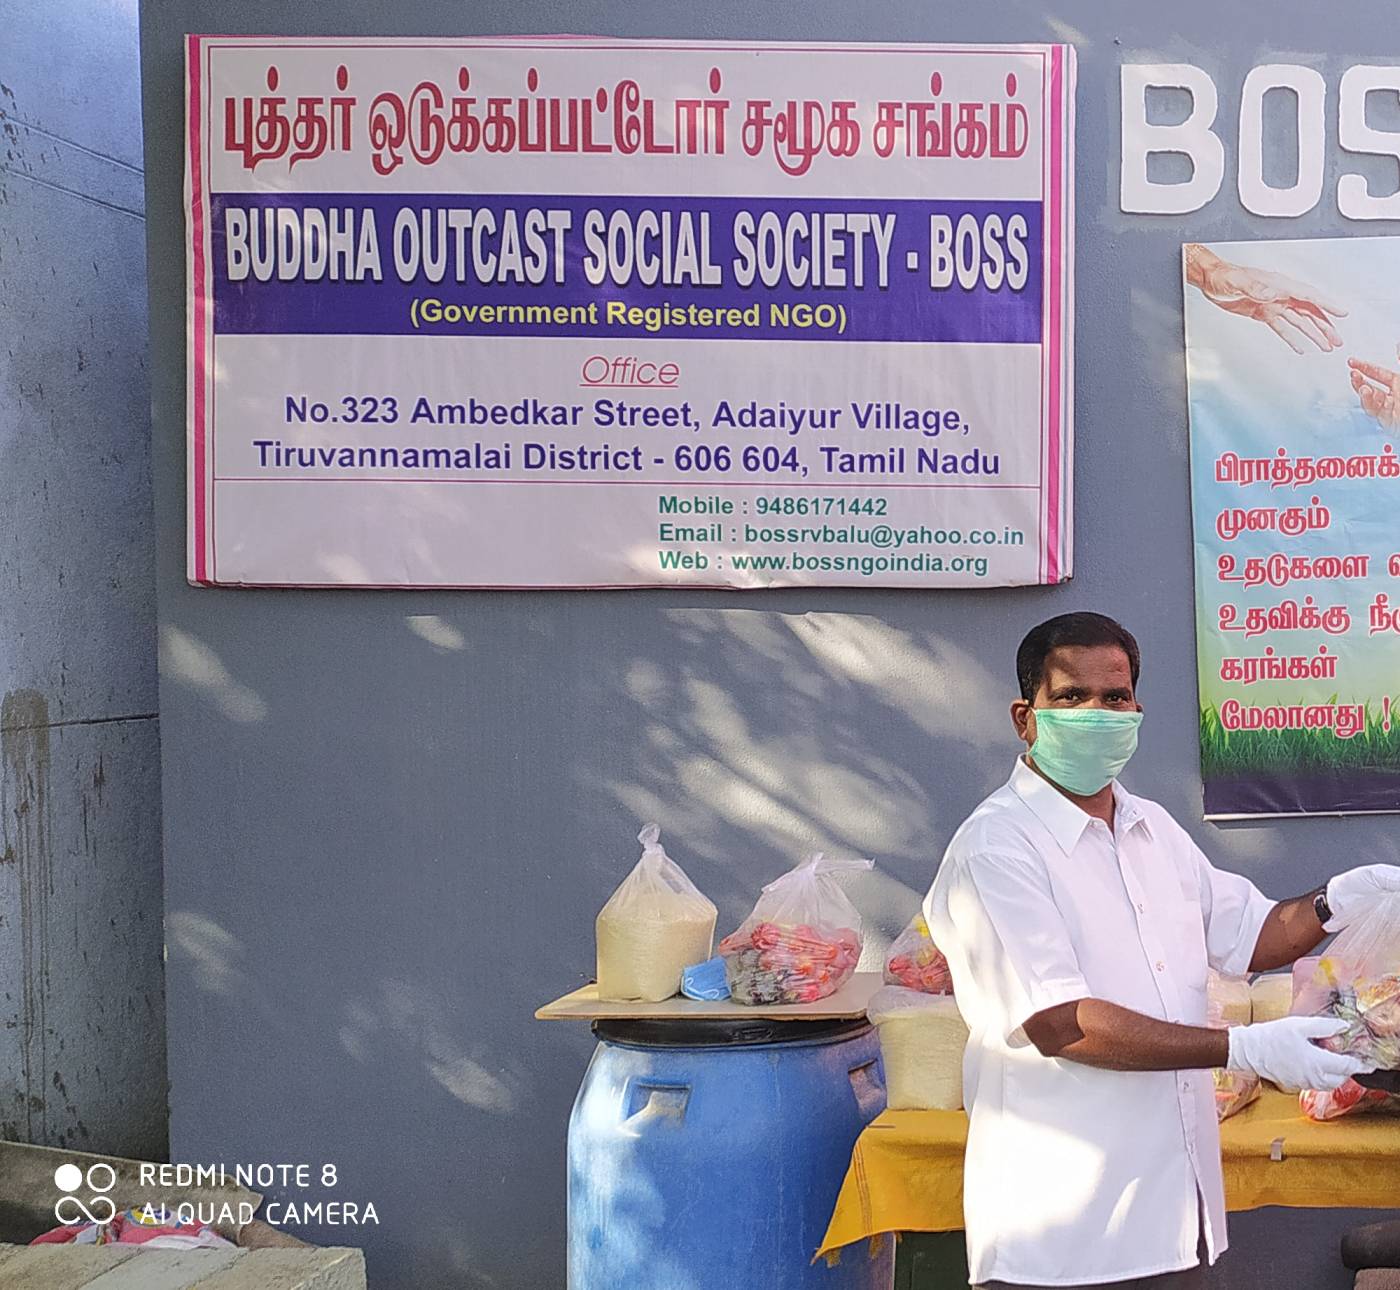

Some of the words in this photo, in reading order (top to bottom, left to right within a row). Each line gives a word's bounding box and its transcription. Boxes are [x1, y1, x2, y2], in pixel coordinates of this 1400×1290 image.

[224, 64, 358, 174] புத்தர்
[368, 65, 731, 176] ஒடுக்கப்பட்டோர்
[742, 100, 861, 177] சமூக
[872, 70, 1030, 159] சங்கம்
[224, 207, 383, 282] BUDDHA
[393, 207, 572, 285] OUTCAST
[583, 209, 722, 287] SOCIAL
[732, 211, 897, 290] SOCIETY
[906, 250, 919, 270] -
[930, 213, 1029, 291] BOSS
[410, 298, 598, 328] (Government
[607, 301, 760, 332] Registered
[770, 304, 847, 334] NGO)
[580, 355, 680, 388] Office
[285, 396, 399, 424] No.323
[410, 397, 583, 427] Ambedkar
[593, 399, 701, 431] Street,
[712, 401, 842, 436] Adaiyur
[851, 402, 970, 437] Village,
[253, 440, 511, 470] Tiruvannamalai
[523, 443, 643, 471] District
[674, 446, 731, 473] 606
[742, 446, 809, 477] 604,
[819, 446, 905, 474] Tamil
[917, 447, 1001, 475] Nadu
[658, 495, 734, 515] Mobile
[756, 497, 888, 516] 9486171442
[1217, 496, 1331, 540] முனகும்
[659, 523, 722, 543] Email
[744, 524, 1024, 549] bossrvbalu@yahoo.co.in
[658, 550, 709, 571] Web
[732, 553, 988, 575] www.bossngoindia.org
[1218, 554, 1369, 590] உதடுகளை
[1219, 596, 1350, 638] உதவிக்கு
[1220, 645, 1337, 684] கரங்கள்
[1221, 699, 1364, 738] மேலானது
